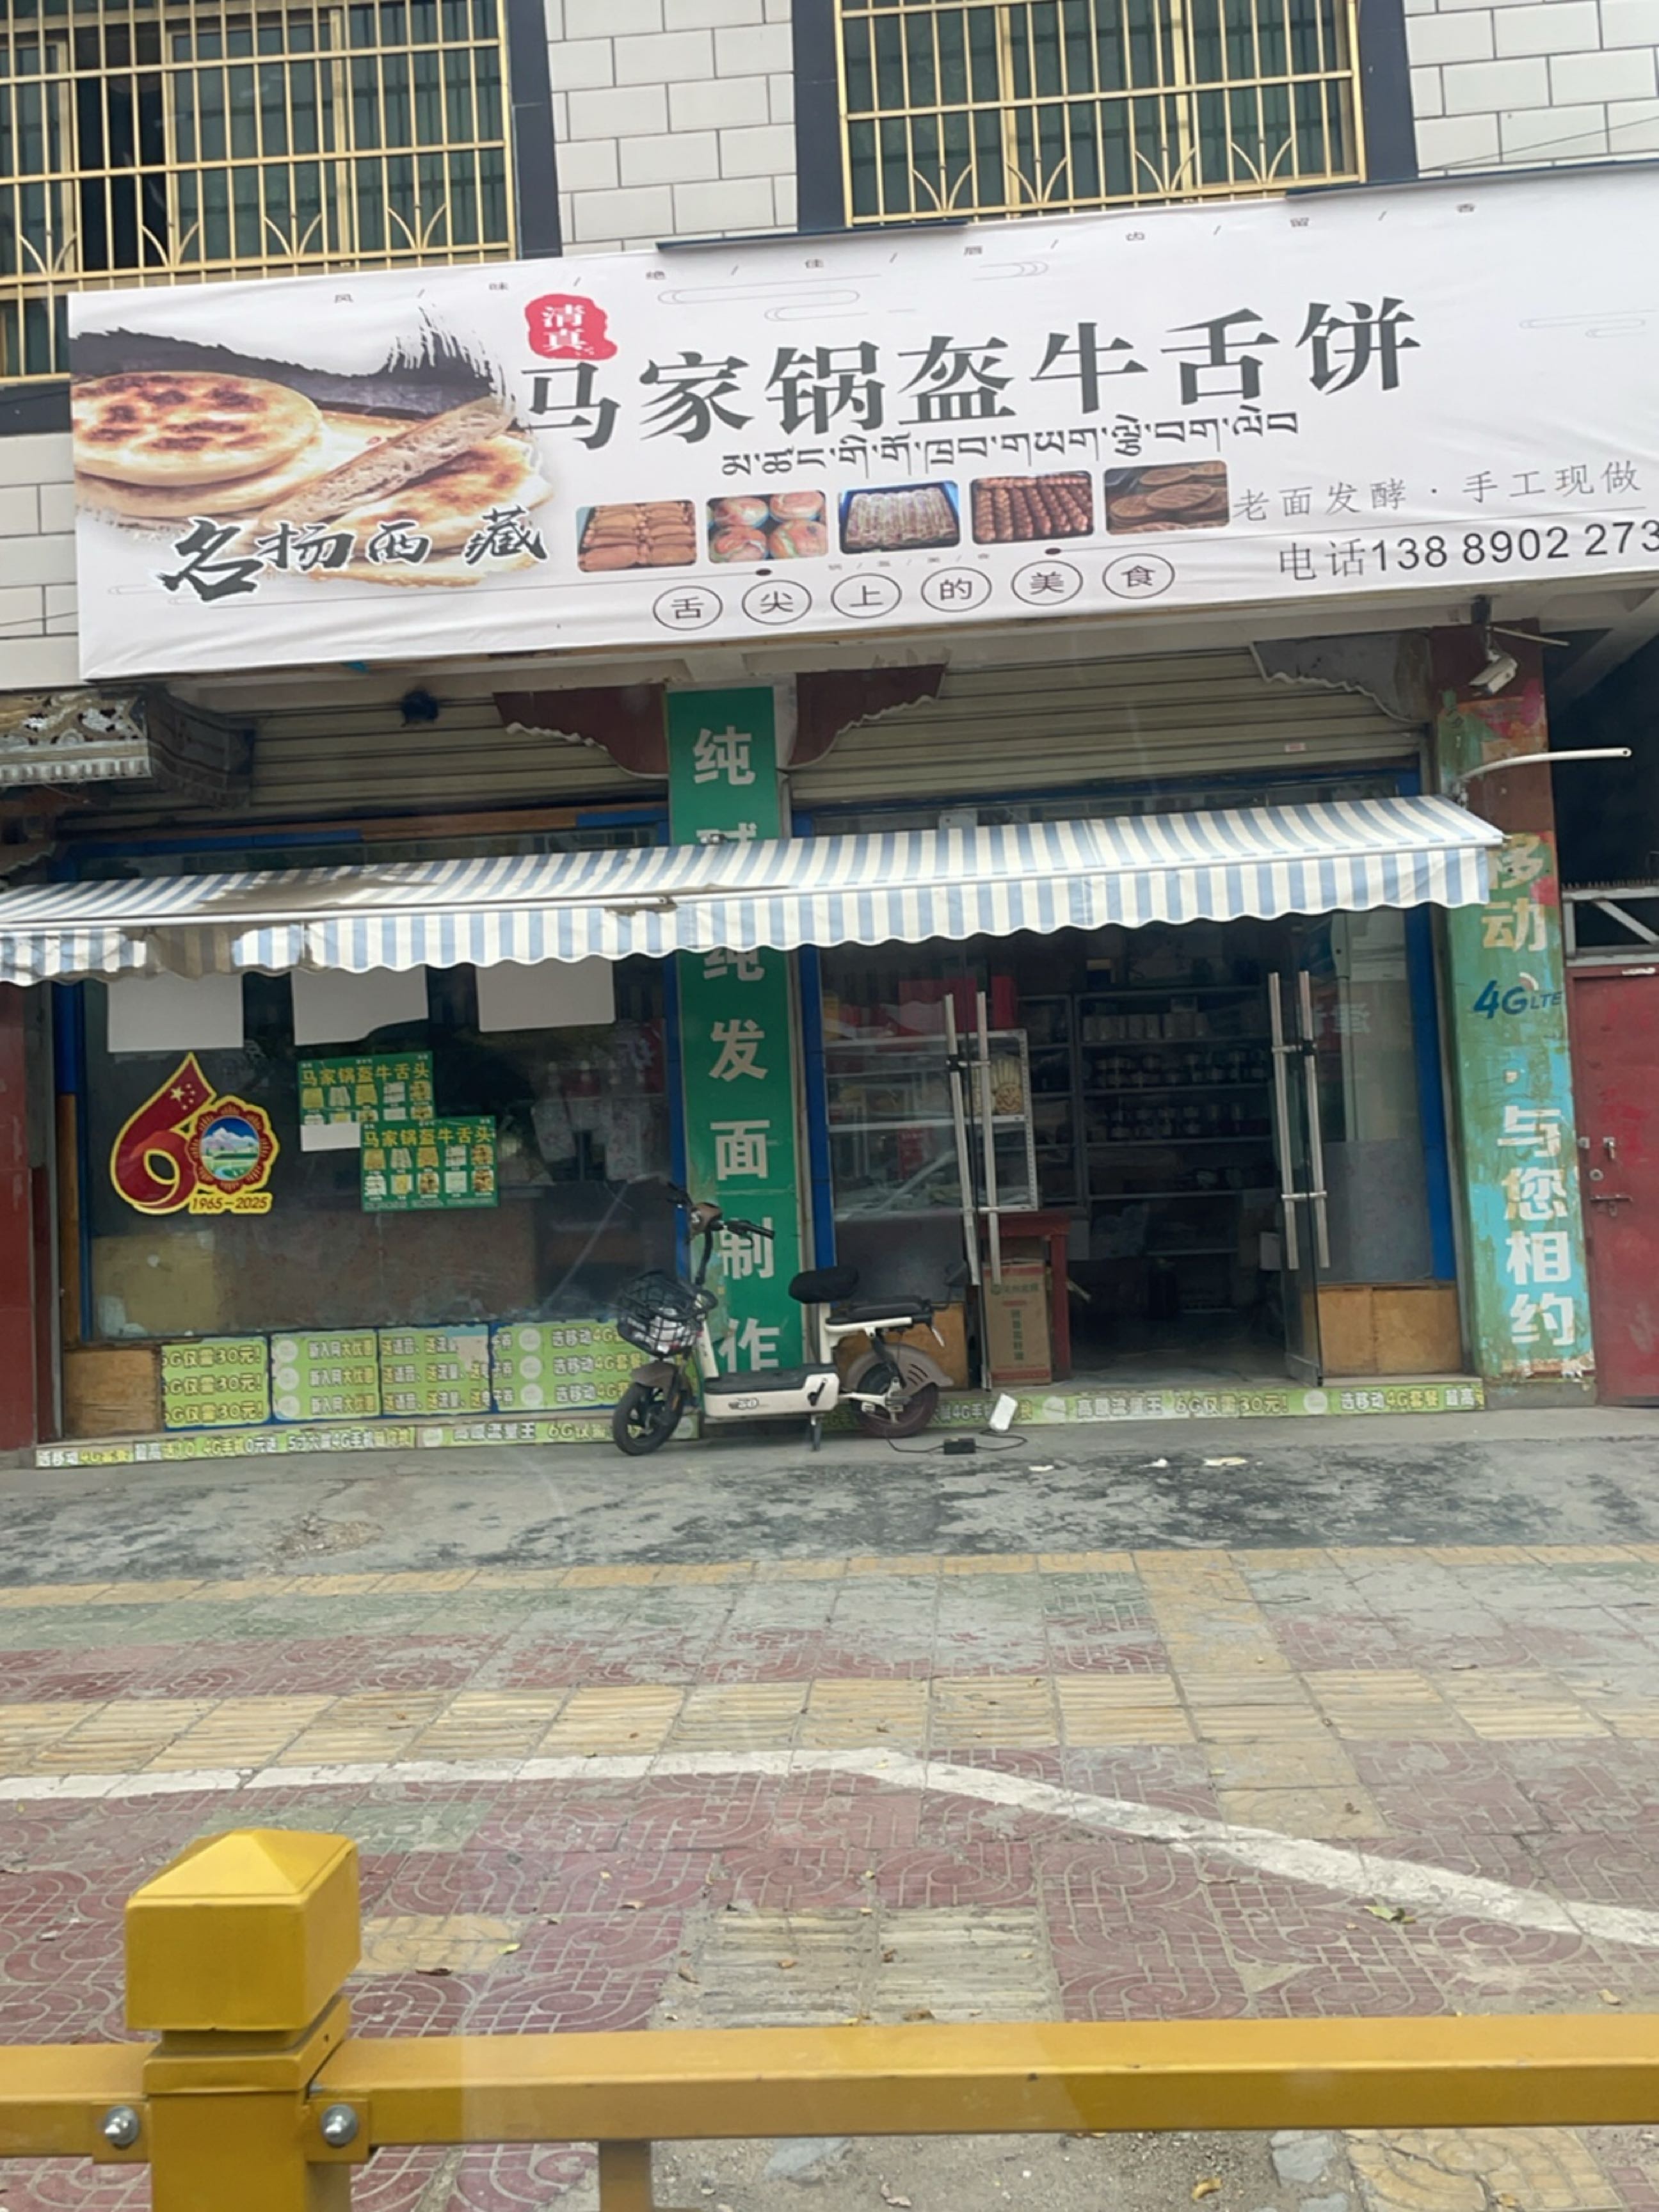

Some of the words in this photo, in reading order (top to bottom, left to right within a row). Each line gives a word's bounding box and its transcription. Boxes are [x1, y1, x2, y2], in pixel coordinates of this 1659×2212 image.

[541, 305, 587, 352] 清真
[521, 295, 1421, 451] 马家锅盔牛舌饼
[159, 507, 549, 604] 名扬西藏
[1463, 525, 1569, 567] 8902
[671, 565, 1155, 621] 舌尖上的美食
